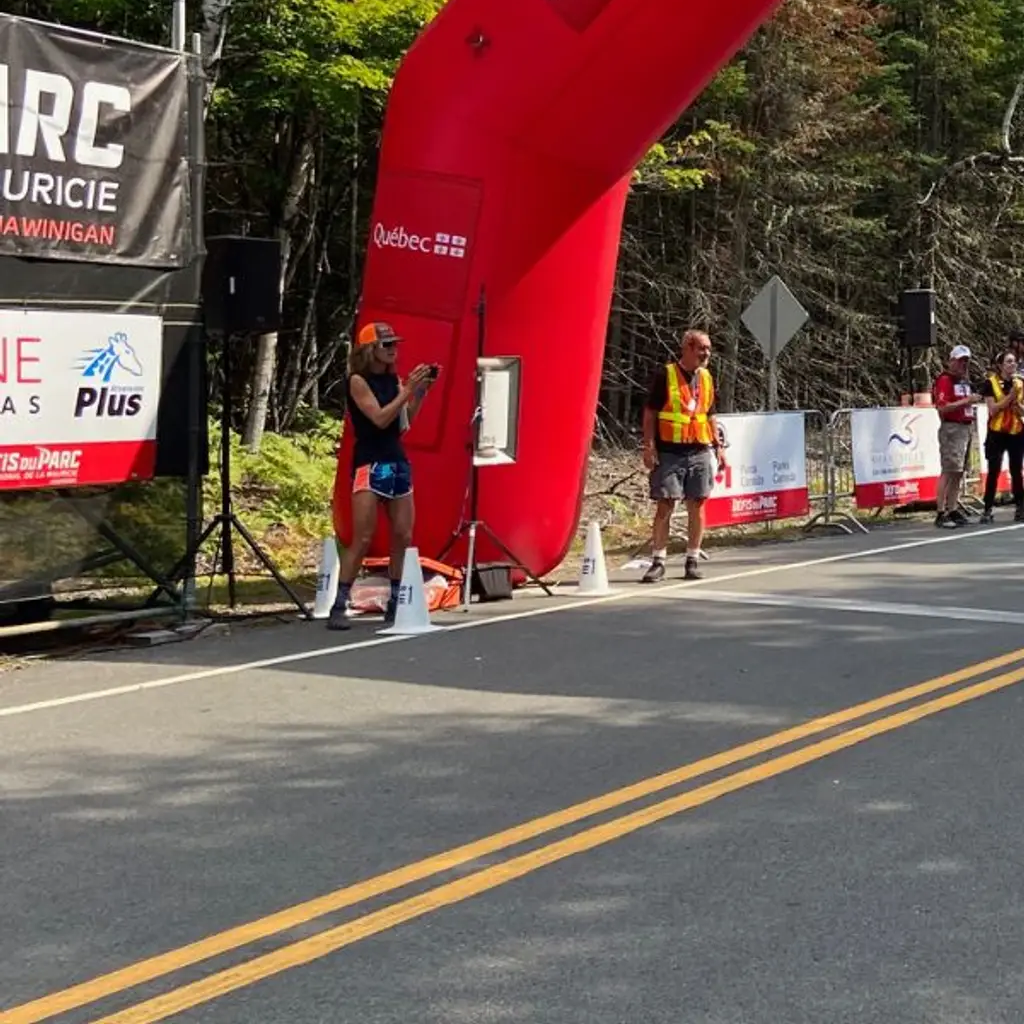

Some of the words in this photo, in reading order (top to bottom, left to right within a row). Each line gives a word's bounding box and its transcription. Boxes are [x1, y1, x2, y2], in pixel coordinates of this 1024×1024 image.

[0, 64, 131, 169] RC
[3, 169, 119, 212] URICIE
[374, 222, 431, 252] Québec
[74, 387, 142, 417] Plus
[35, 445, 82, 470] PARC
